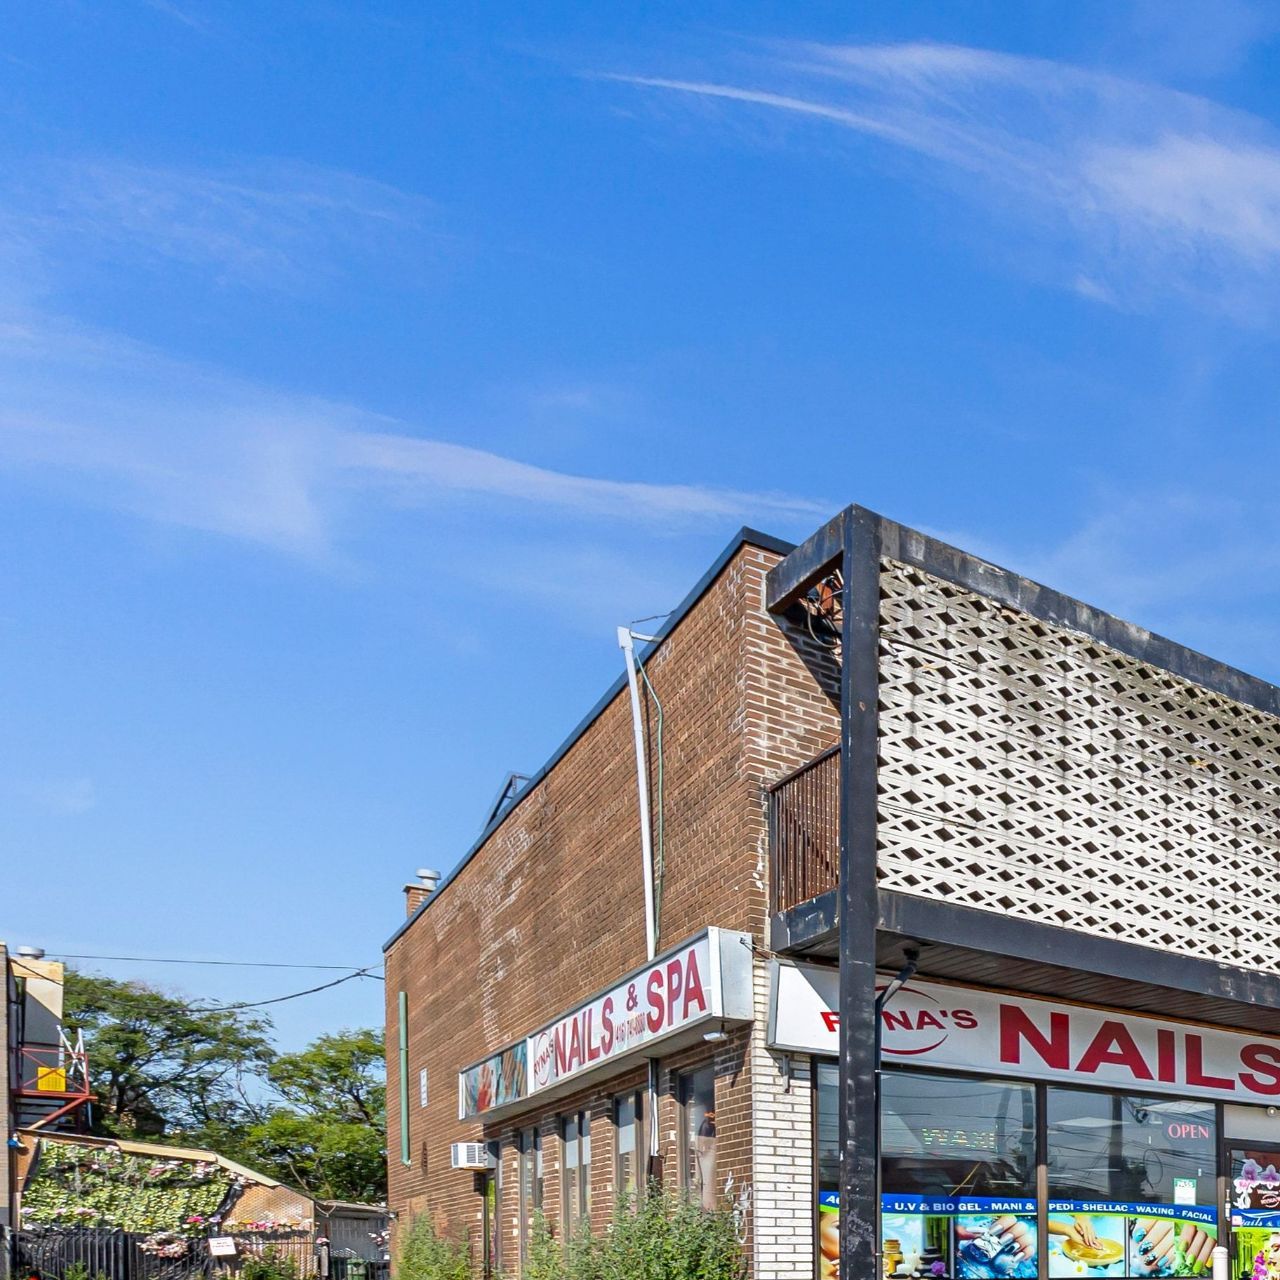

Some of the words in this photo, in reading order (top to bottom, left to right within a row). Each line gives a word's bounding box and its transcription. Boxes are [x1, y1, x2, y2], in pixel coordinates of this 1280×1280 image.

[554, 997, 614, 1077] NAILS
[626, 983, 638, 1012] &
[647, 949, 707, 1033] SPA
[820, 1009, 978, 1032] RNA'S
[1168, 1123, 1209, 1139] OPEN
[894, 1202, 916, 1212] U.V
[919, 1203, 930, 1212] &
[933, 1202, 955, 1212] BIO
[958, 1202, 982, 1212] GEL
[991, 1202, 1023, 1211] MANI
[1025, 1202, 1035, 1211] &
[1048, 1202, 1075, 1212] PEDI
[1082, 1203, 1129, 1213] SHELLAC
[1136, 1205, 1175, 1216] WAXING
[1181, 1210, 1214, 1222] FACIAL
[1240, 1217, 1263, 1227] ails
